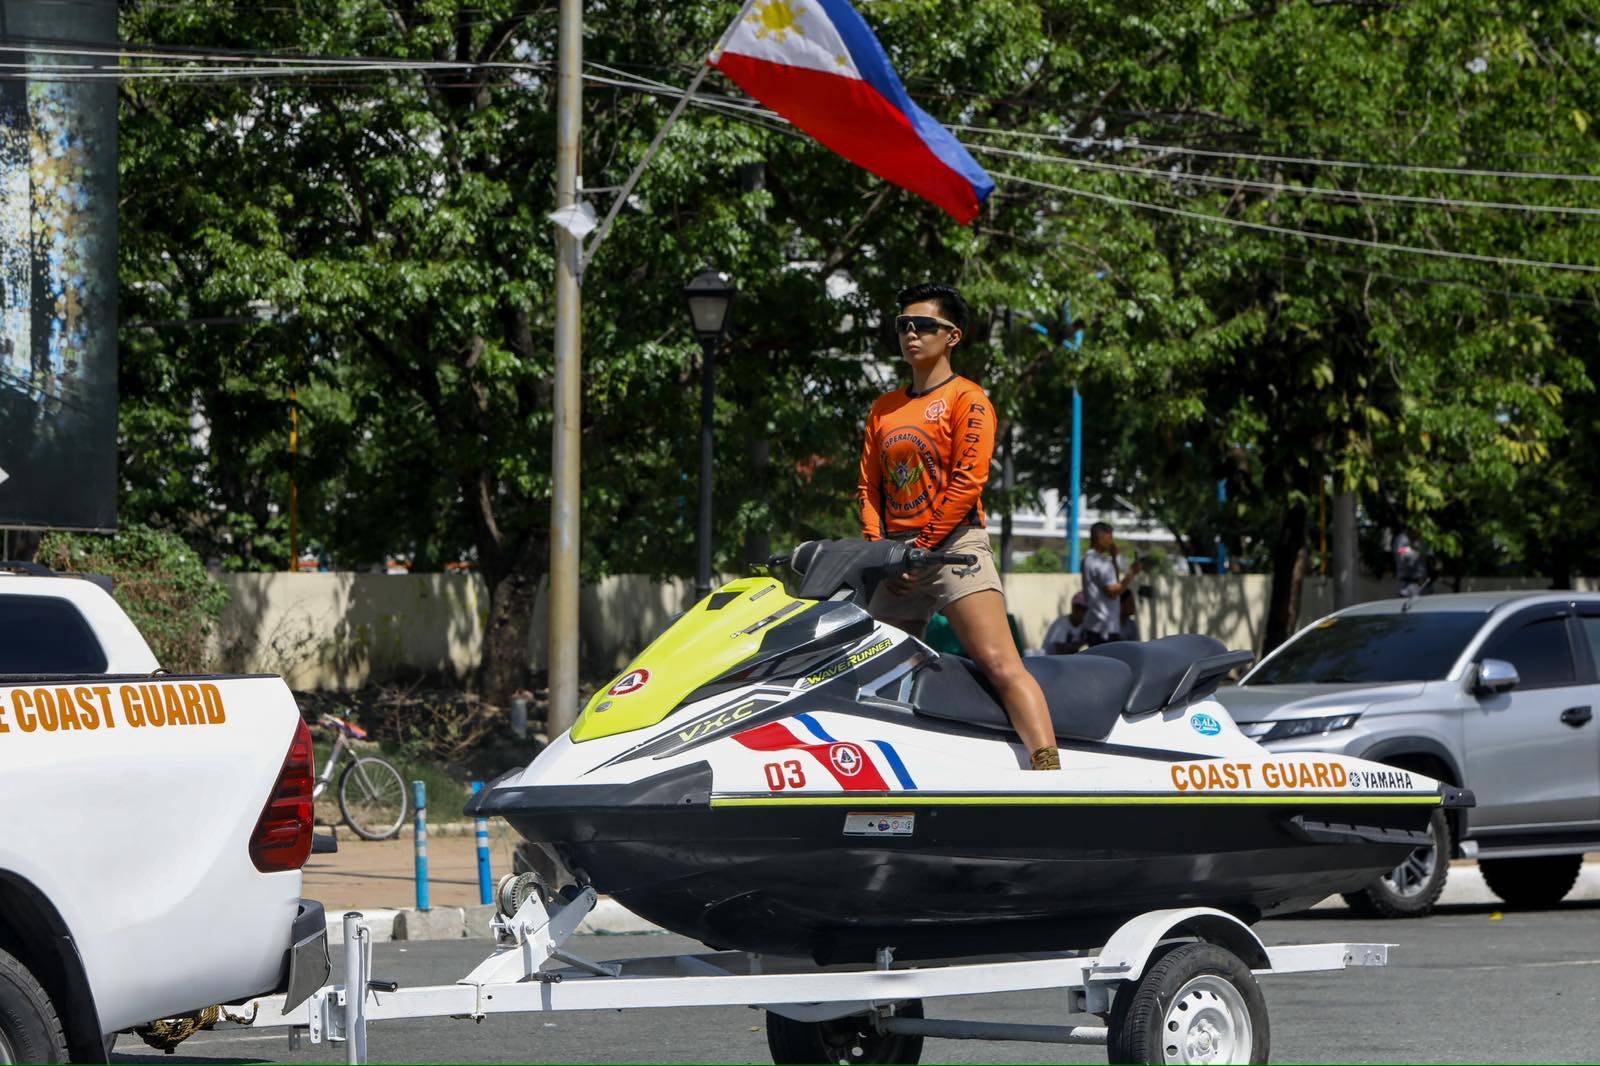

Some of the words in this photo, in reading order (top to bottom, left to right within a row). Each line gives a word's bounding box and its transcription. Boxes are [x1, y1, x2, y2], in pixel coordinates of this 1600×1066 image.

[885, 433, 927, 451] OPERATIONS
[806, 637, 893, 685] WAVERUNNER
[11, 686, 115, 733] COAST
[119, 683, 226, 728] GUARD
[763, 760, 807, 791] 03
[1170, 762, 1253, 791] COAST
[1262, 762, 1347, 789] GUARD
[1362, 771, 1414, 789] YAMAHA
